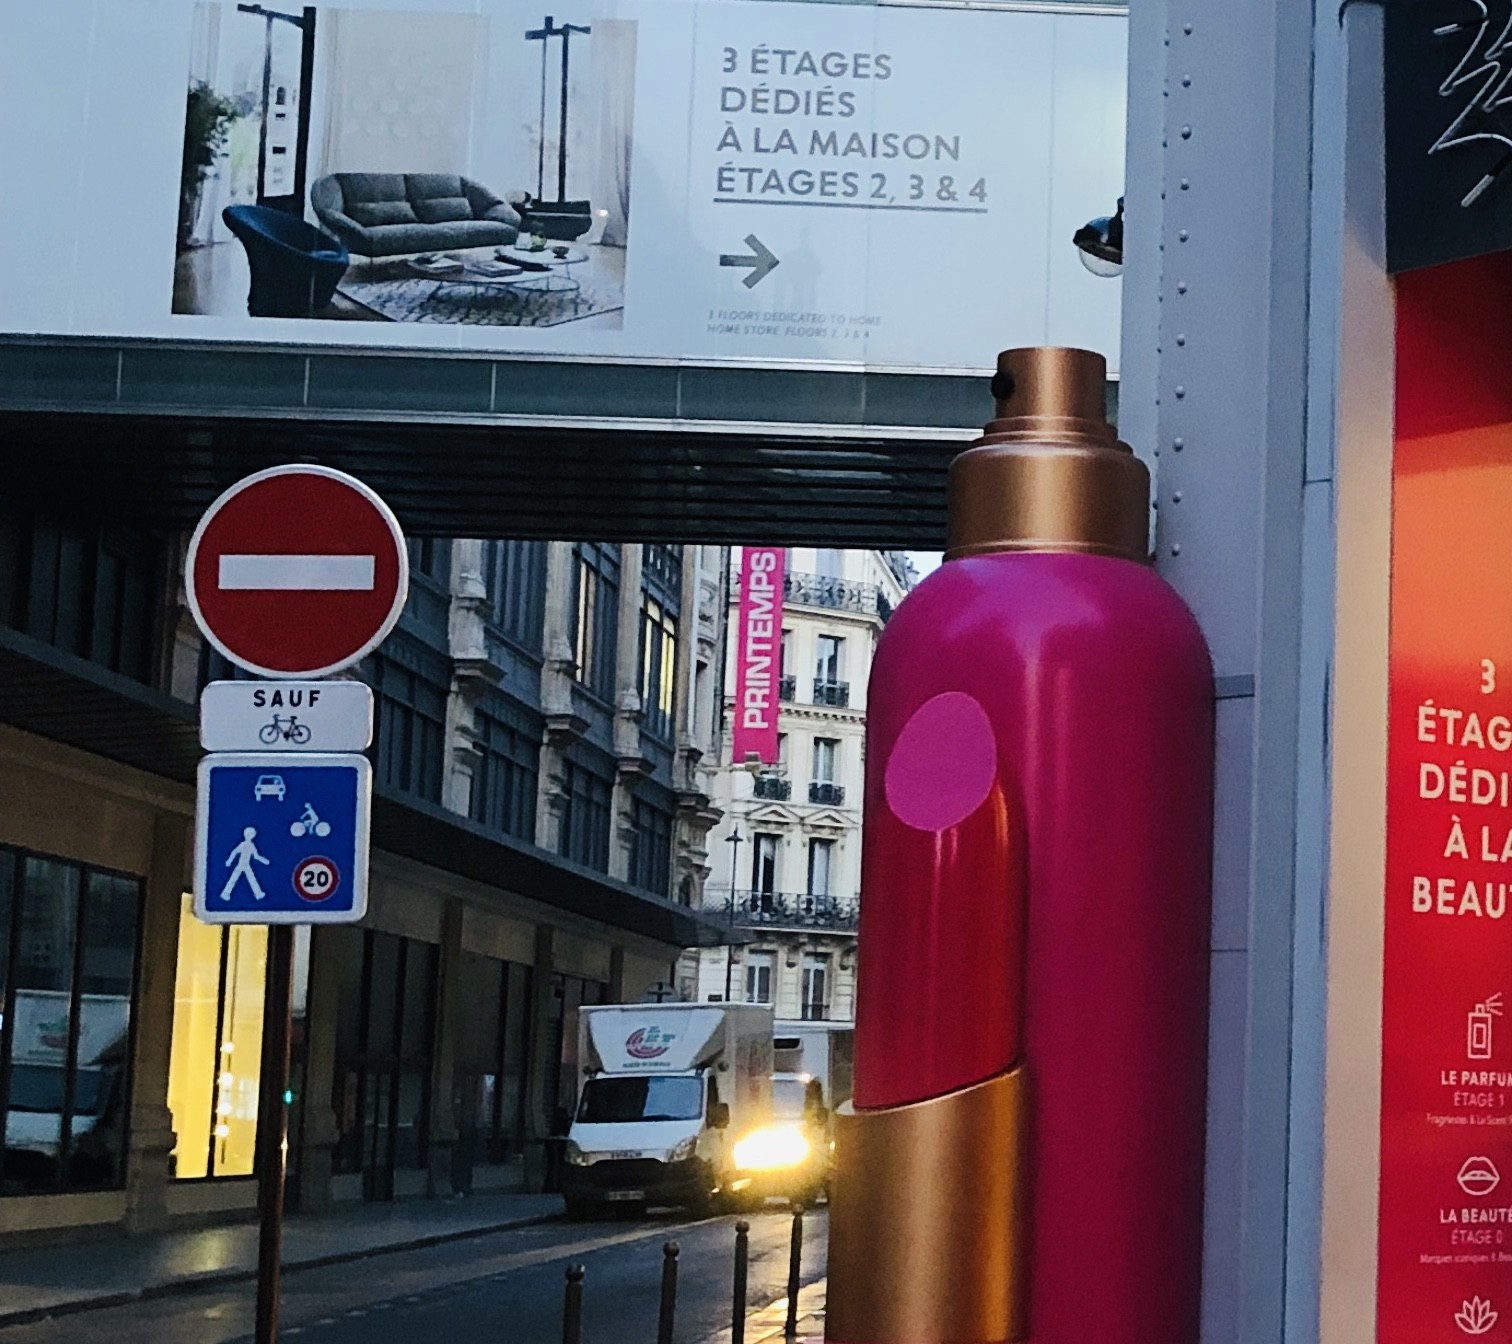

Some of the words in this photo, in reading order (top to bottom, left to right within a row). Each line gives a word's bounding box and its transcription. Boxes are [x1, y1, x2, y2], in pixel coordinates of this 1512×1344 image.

[722, 47, 738, 73] 3
[750, 44, 892, 80] ÉTAGES
[720, 83, 856, 118] DÉDIÉS
[716, 120, 743, 152] À
[753, 127, 798, 155] LA
[809, 129, 960, 161] MAISON
[716, 162, 860, 199] ÉTAGES
[870, 172, 896, 203] 2,
[909, 174, 924, 200] 3
[936, 175, 959, 202] &
[969, 177, 988, 203] 4
[743, 551, 777, 730] PRINTEMPS
[1480, 658, 1496, 694] 3
[253, 689, 321, 708] SAUF
[1443, 814, 1469, 859] À
[303, 870, 330, 888] 20
[1441, 1070, 1457, 1086] LE
[1499, 1092, 1505, 1107] 1
[1440, 1208, 1457, 1224] LA
